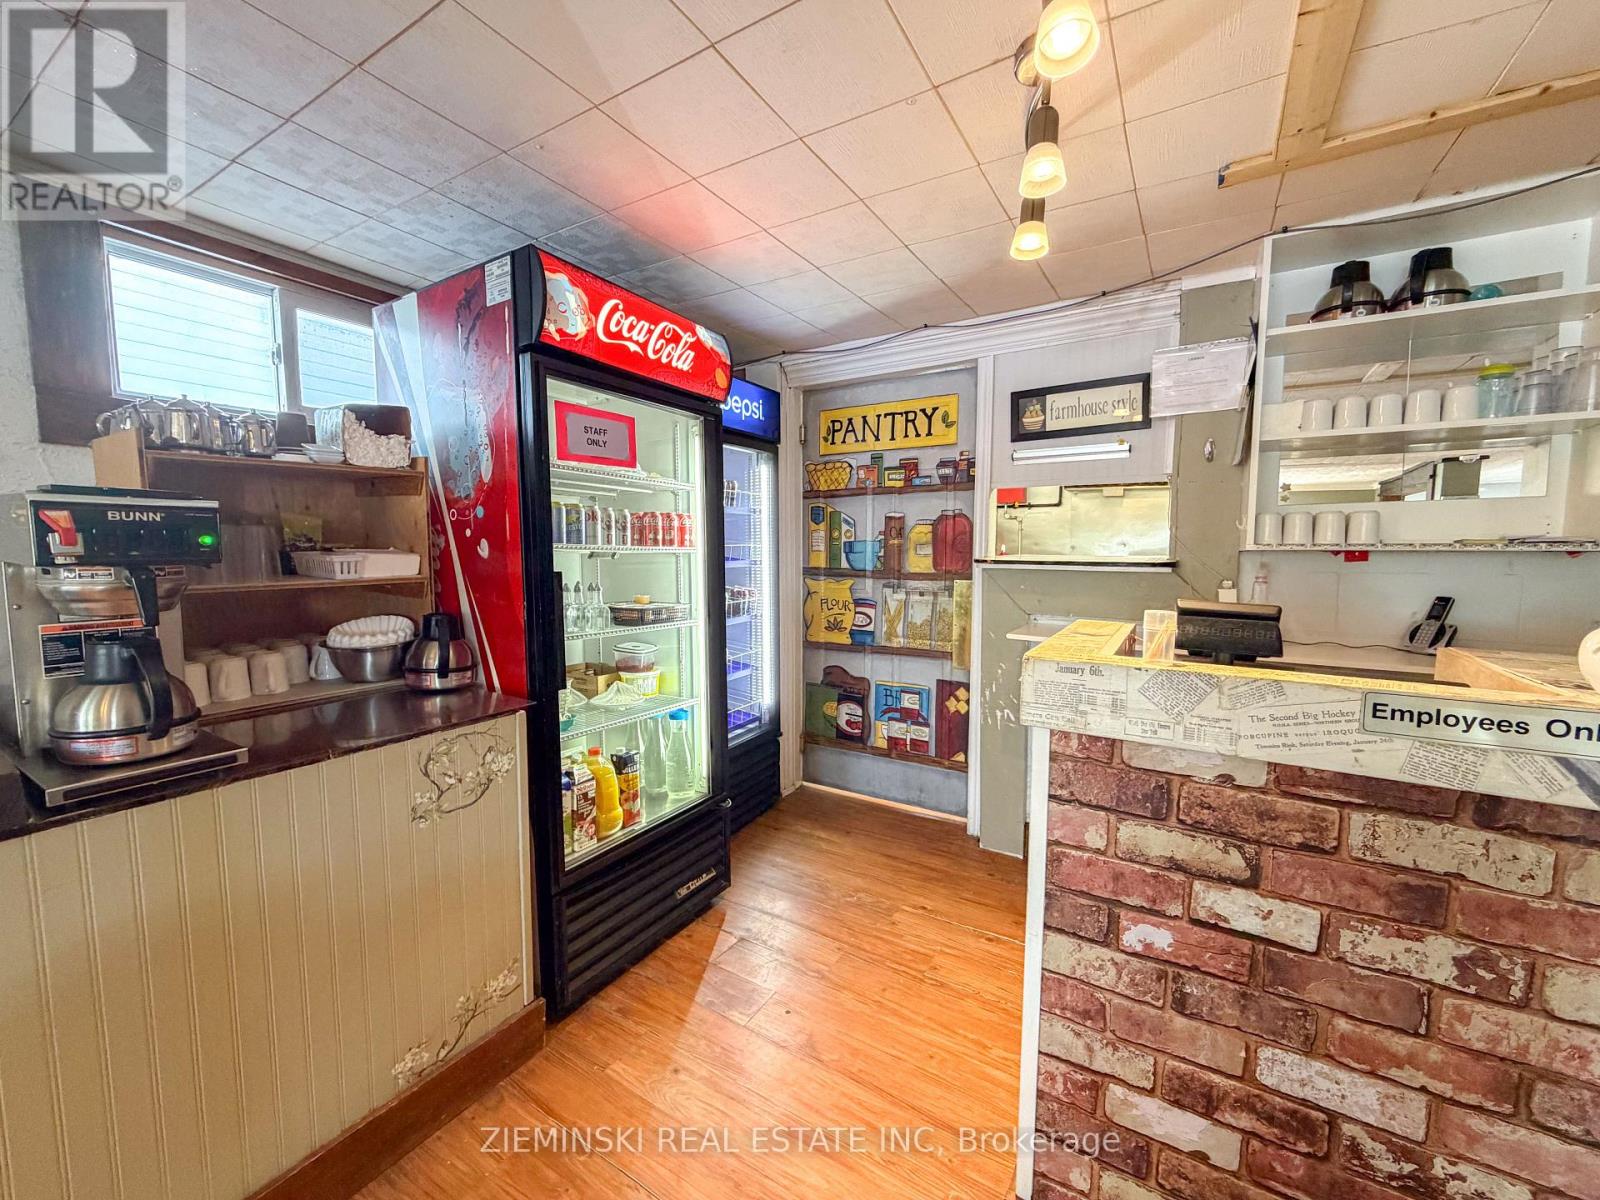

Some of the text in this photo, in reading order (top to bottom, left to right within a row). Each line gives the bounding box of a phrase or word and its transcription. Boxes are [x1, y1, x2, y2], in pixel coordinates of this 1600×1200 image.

[597, 299, 697, 372] Coca-Cola
[1050, 396, 1108, 421] farmhouse
[583, 425, 608, 436] STAFF
[830, 407, 939, 445] PANTRY
[586, 438, 608, 448] ONLY
[107, 510, 165, 522] BUNN
[820, 598, 851, 612] FLOUR
[1055, 662, 1085, 676] January
[1248, 709, 1356, 724] The Second Big Hockey
[1371, 702, 1530, 735] Employees
